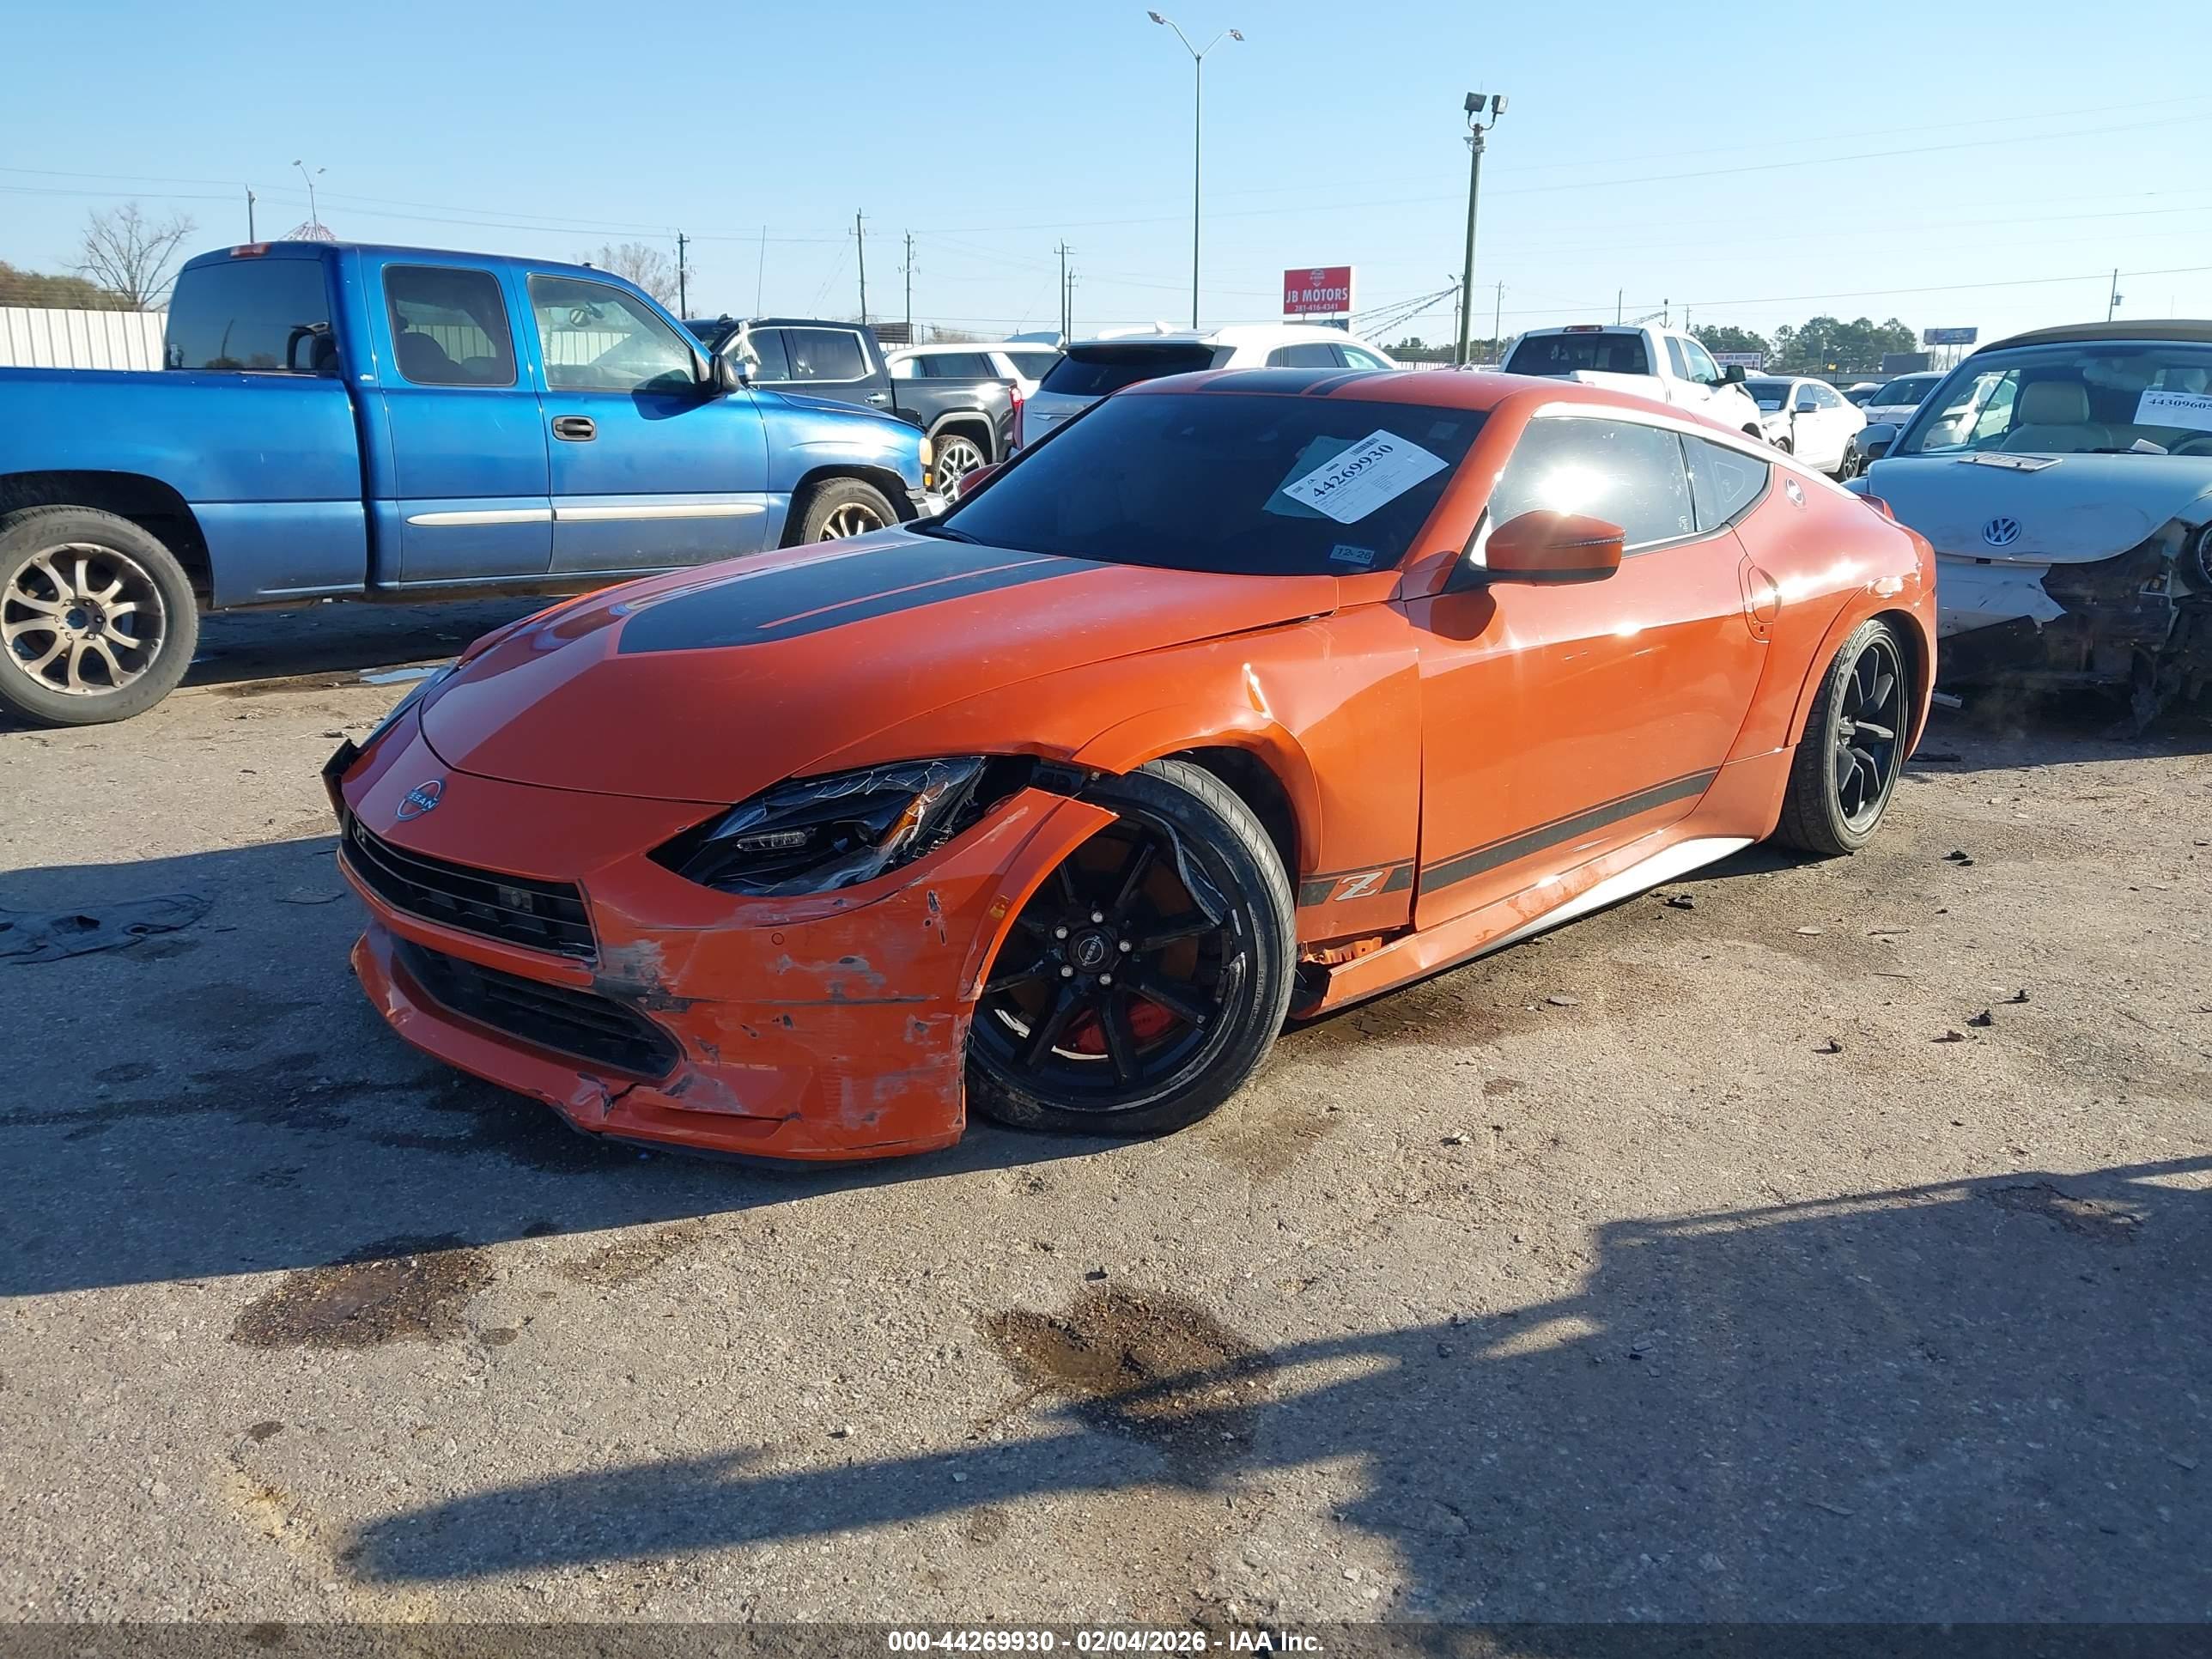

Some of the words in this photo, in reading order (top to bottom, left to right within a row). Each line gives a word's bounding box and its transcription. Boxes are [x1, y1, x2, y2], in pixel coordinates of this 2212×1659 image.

[1285, 289, 1299, 303] JB
[1302, 287, 1348, 303] MOTORS
[1312, 443, 1395, 499] 44269930
[1333, 871, 1384, 902] Z
